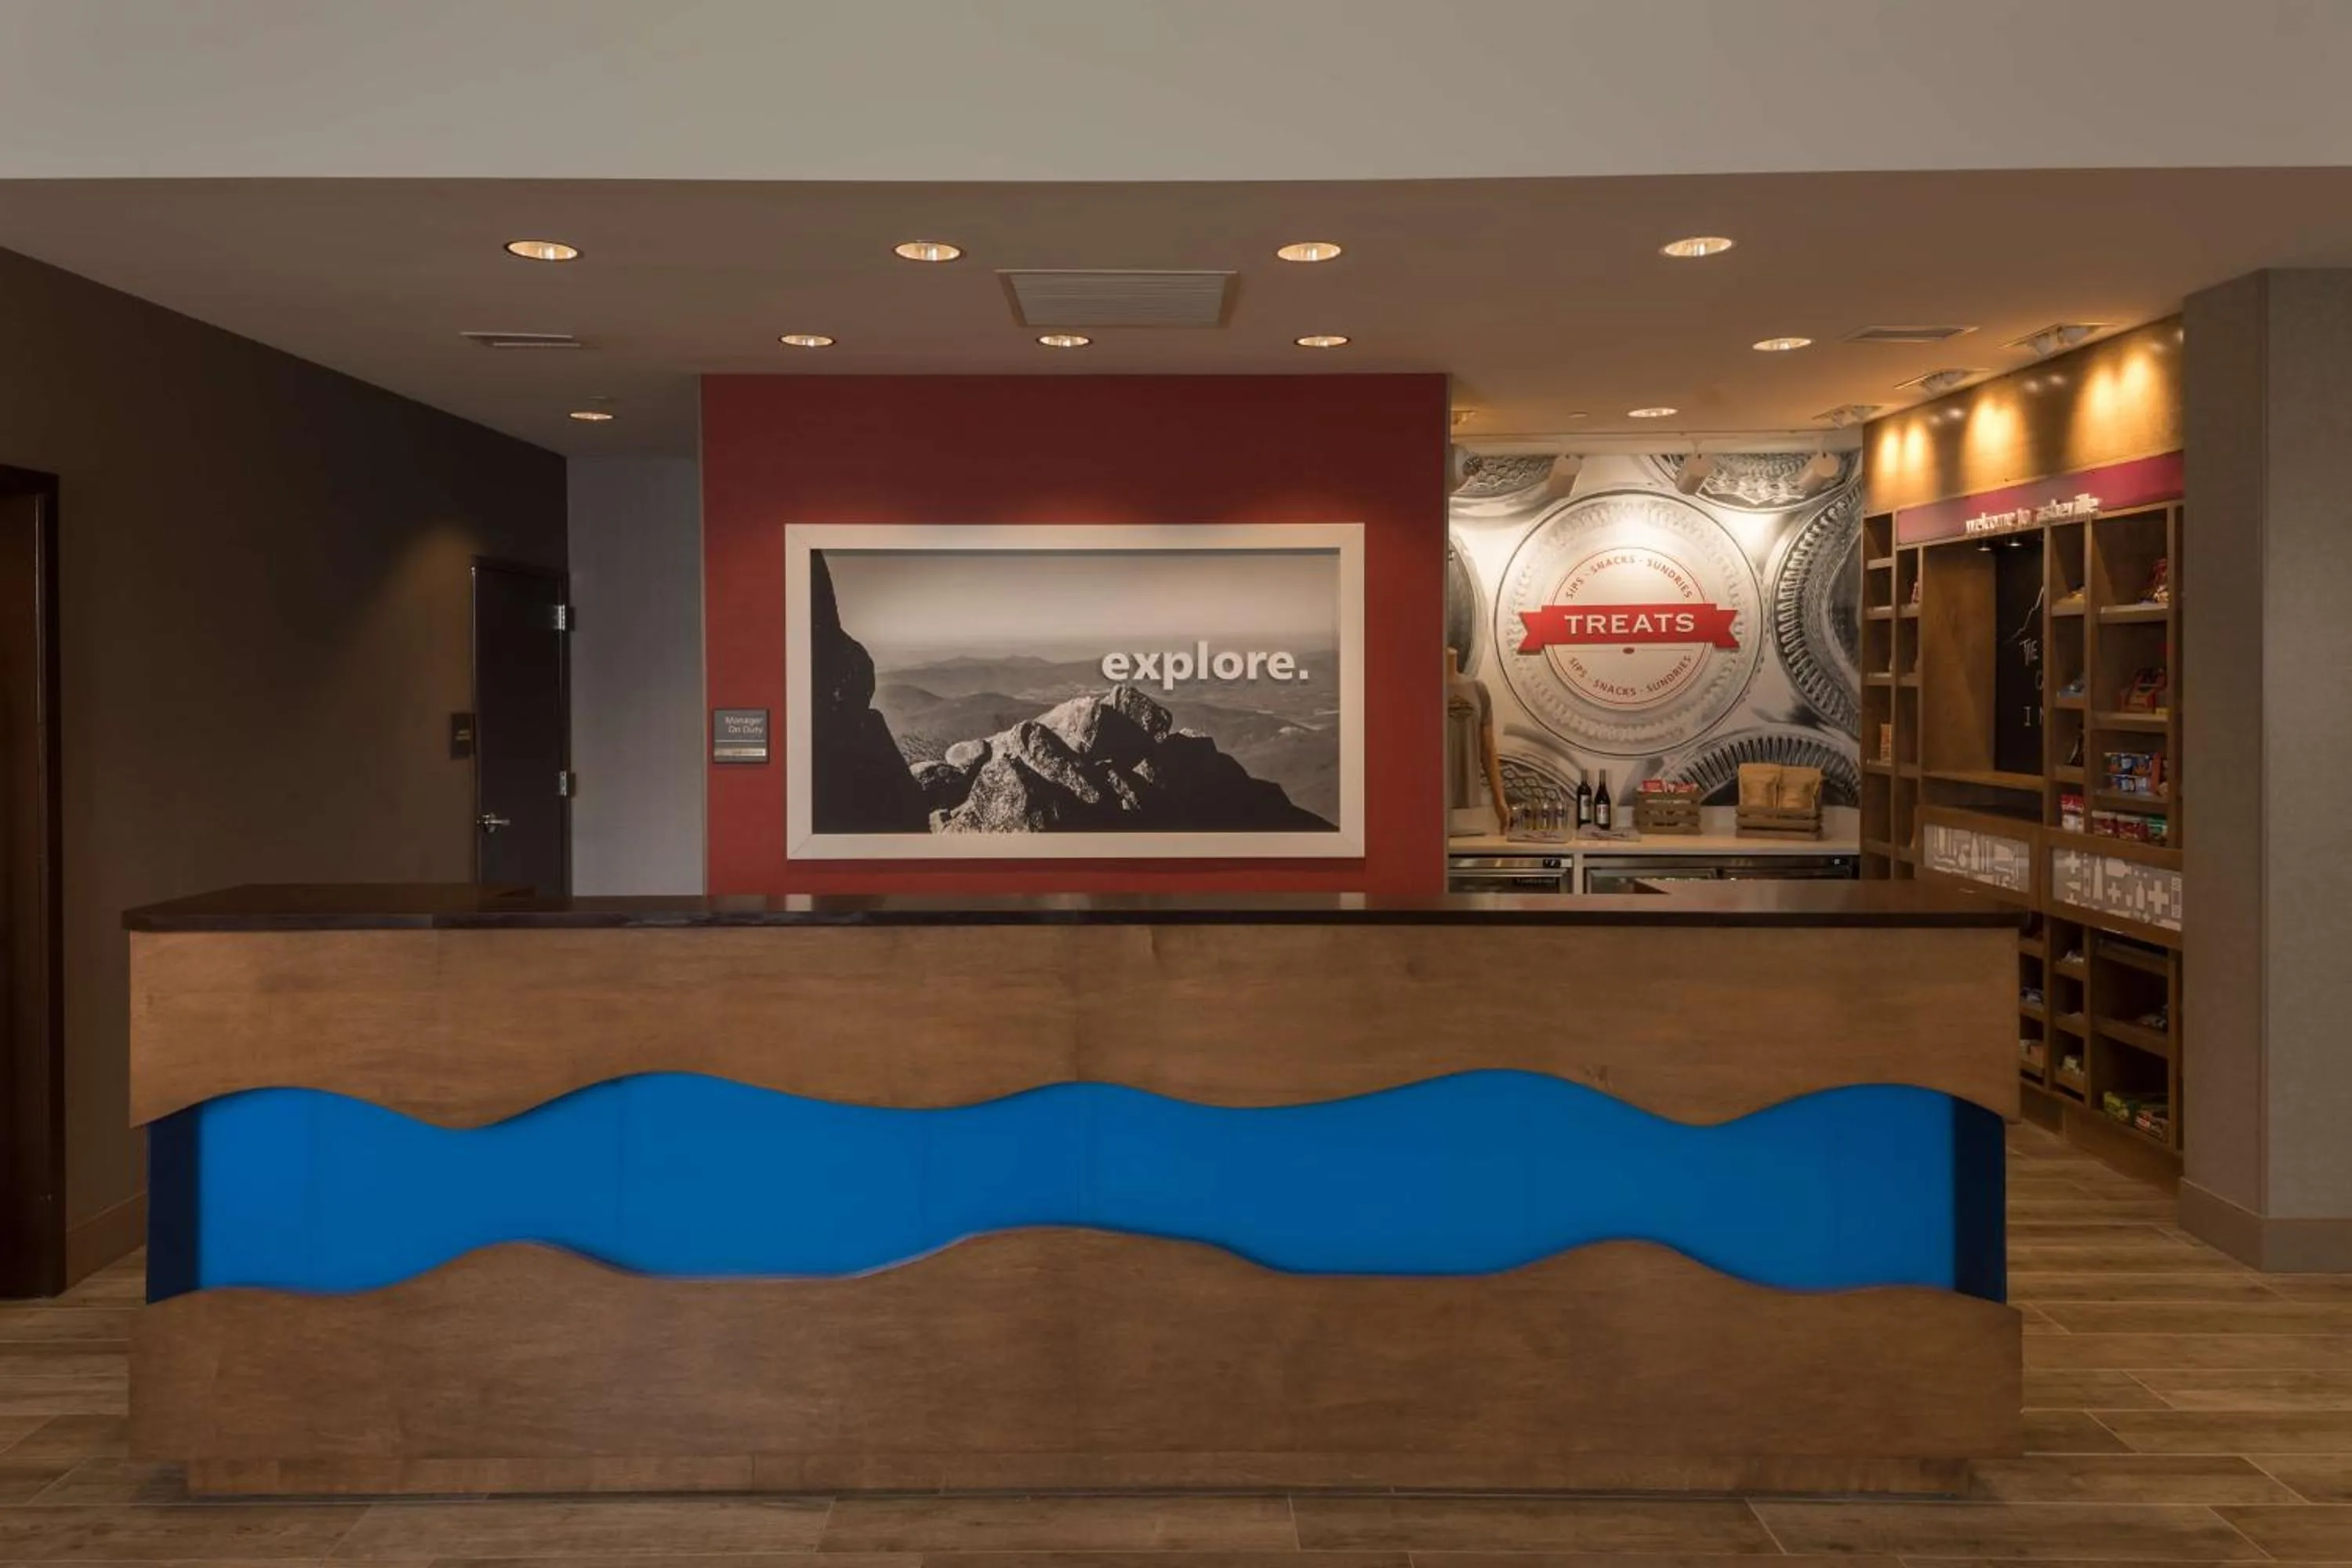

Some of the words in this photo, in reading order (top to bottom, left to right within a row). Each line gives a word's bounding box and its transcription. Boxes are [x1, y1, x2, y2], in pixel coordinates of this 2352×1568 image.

[1965, 512, 2016, 533] welcome
[1566, 577, 1584, 599] SIPS
[1590, 555, 1636, 573] SNACKS
[1647, 558, 1693, 598] SUNDRIES
[1564, 613, 1694, 634] TREATS
[1102, 641, 1308, 690] explore.
[1570, 657, 1588, 678] SIPS
[1592, 680, 1636, 696] SNACKS
[1646, 655, 1691, 693] SUNDRIES
[724, 716, 764, 727] Manager
[743, 725, 764, 735] Duty
